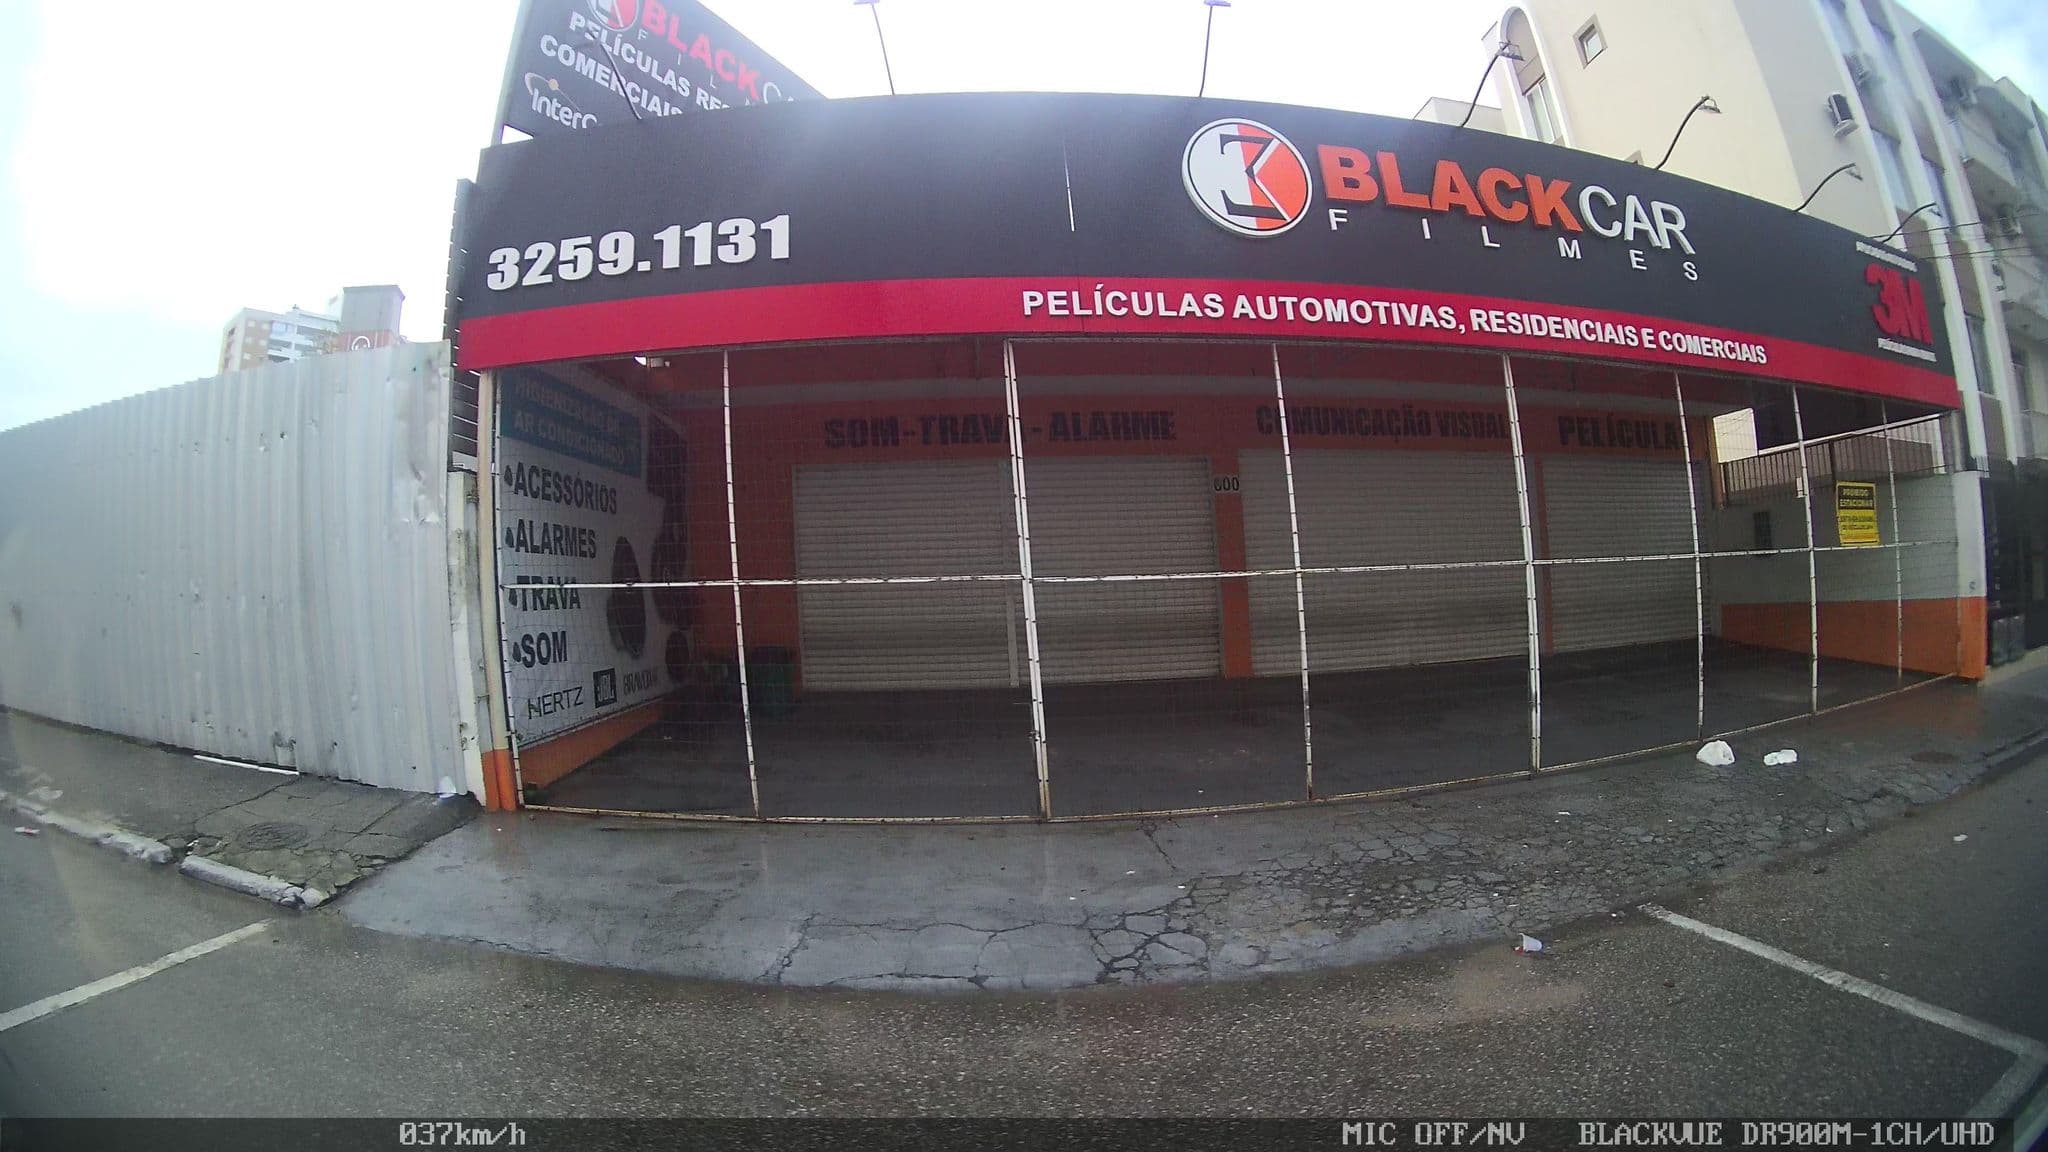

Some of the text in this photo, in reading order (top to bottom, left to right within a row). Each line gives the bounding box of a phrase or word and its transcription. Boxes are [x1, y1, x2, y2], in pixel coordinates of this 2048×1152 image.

[569, 11, 691, 97] PELÍCULAS
[487, 214, 790, 291] 3259.1131
[1023, 284, 1767, 364] PELÍCULAS AUTOMOTIVAS, RESIDENCIAIS E COMERCIAIS
[1864, 262, 1934, 345] 3M
[514, 461, 617, 515] ACESSÓRIOS
[515, 518, 597, 559] ALARMES
[517, 575, 581, 611] TRAVA
[521, 630, 568, 668] SOM
[527, 686, 584, 720] HERTZ
